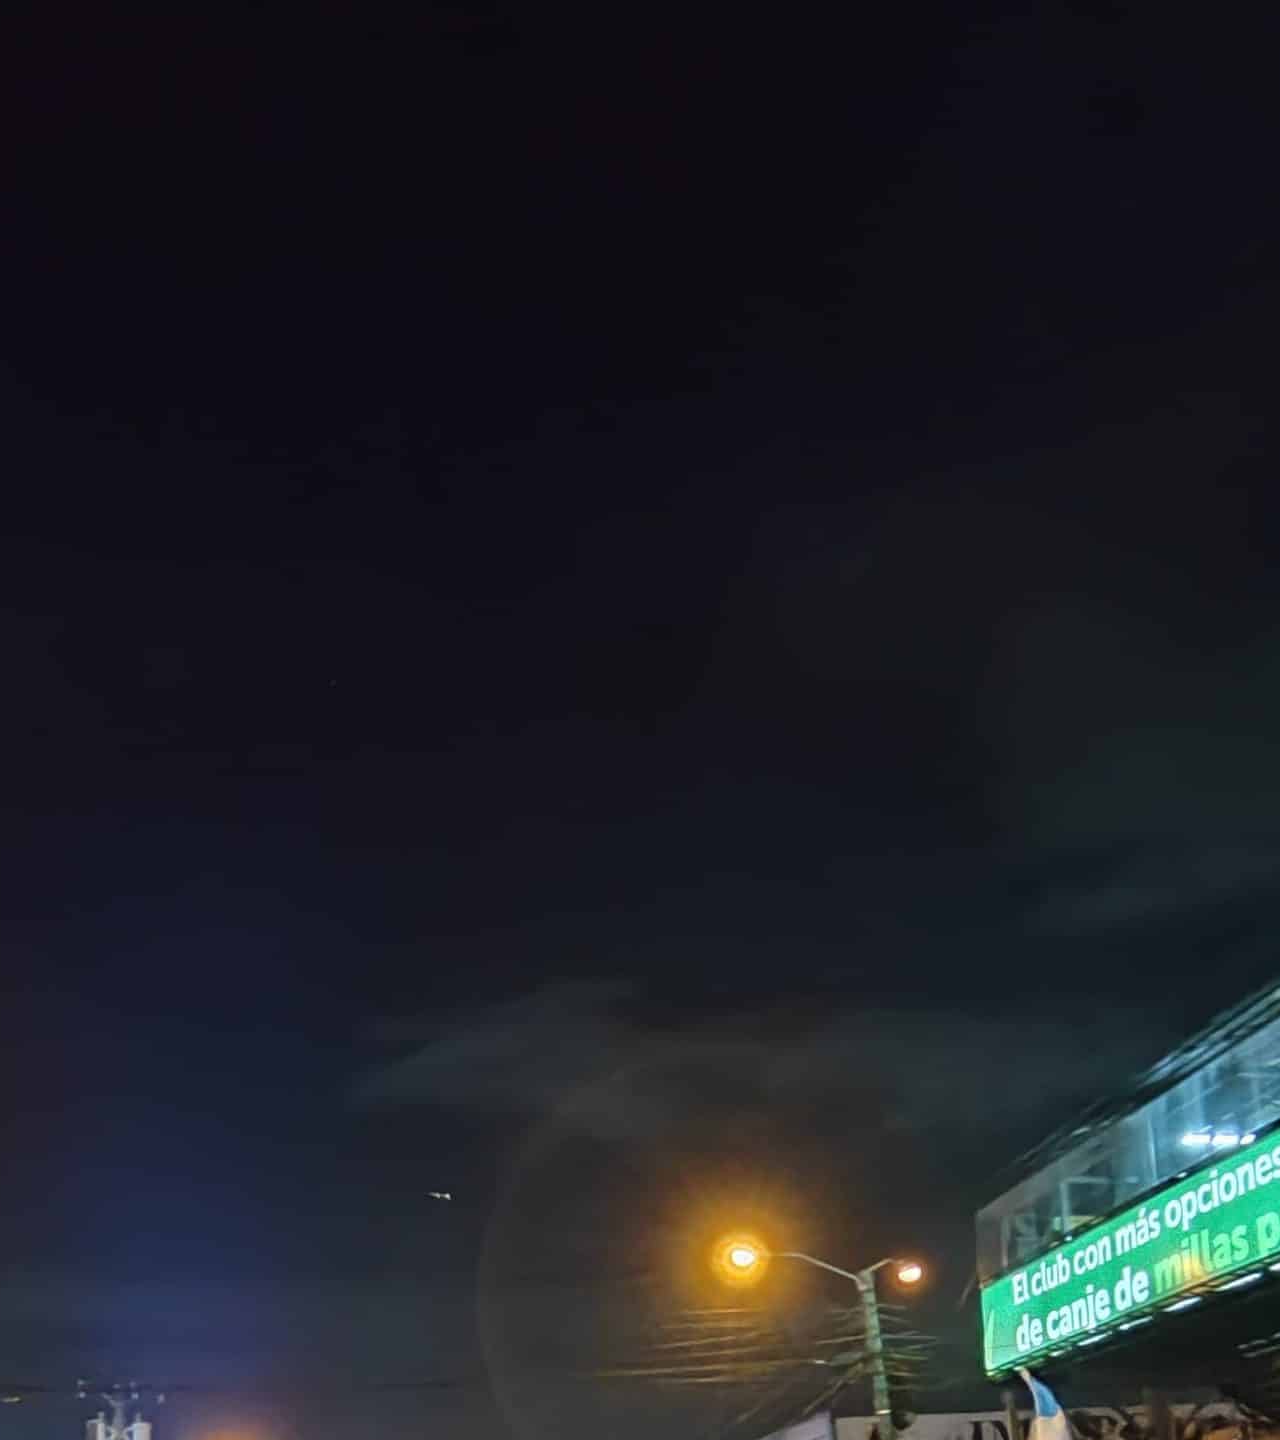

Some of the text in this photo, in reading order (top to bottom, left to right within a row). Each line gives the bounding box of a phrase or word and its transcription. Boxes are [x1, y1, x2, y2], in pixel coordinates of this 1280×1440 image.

[1011, 1273, 1030, 1305] El
[1031, 1253, 1070, 1296] club
[1073, 1236, 1112, 1275] con
[1115, 1207, 1161, 1257] más
[1015, 1314, 1043, 1352] de
[1046, 1284, 1111, 1332] canje
[1114, 1267, 1149, 1311] de
[1153, 1222, 1250, 1295] millas
